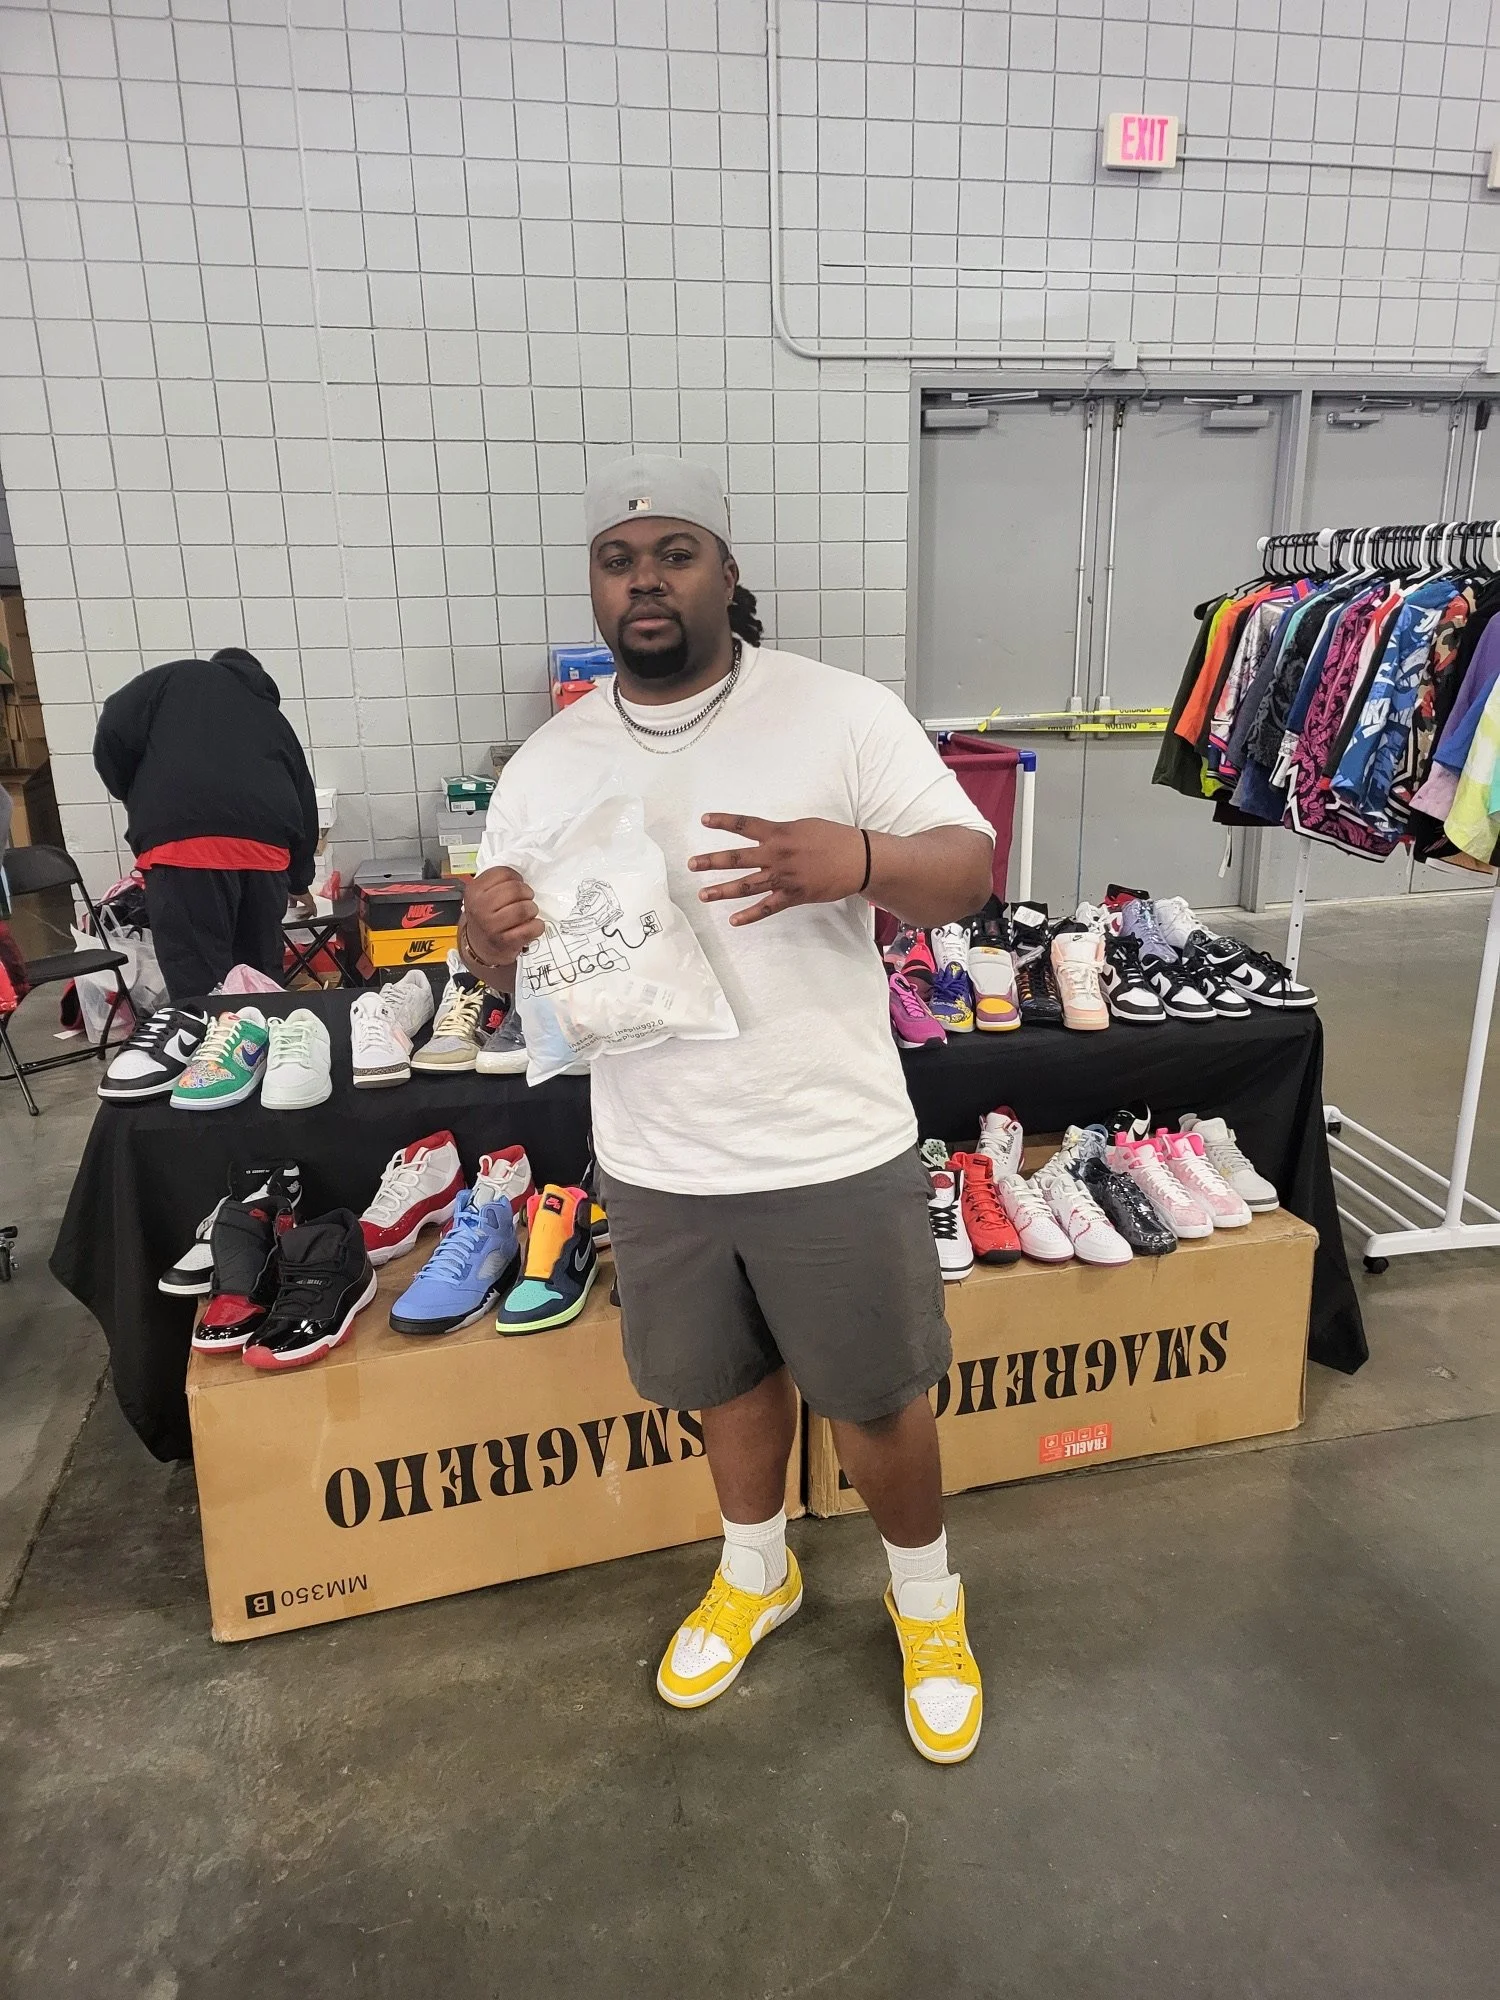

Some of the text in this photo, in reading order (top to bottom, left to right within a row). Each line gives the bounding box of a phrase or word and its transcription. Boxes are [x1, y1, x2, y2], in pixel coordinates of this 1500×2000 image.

[1122, 117, 1169, 161] EXIT
[408, 904, 434, 918] NIKE
[409, 940, 435, 953] NIKE
[1064, 1437, 1107, 1458] FRAGILE
[325, 1408, 707, 1528] SMAGREHO
[254, 1574, 368, 1613] MM350 B
